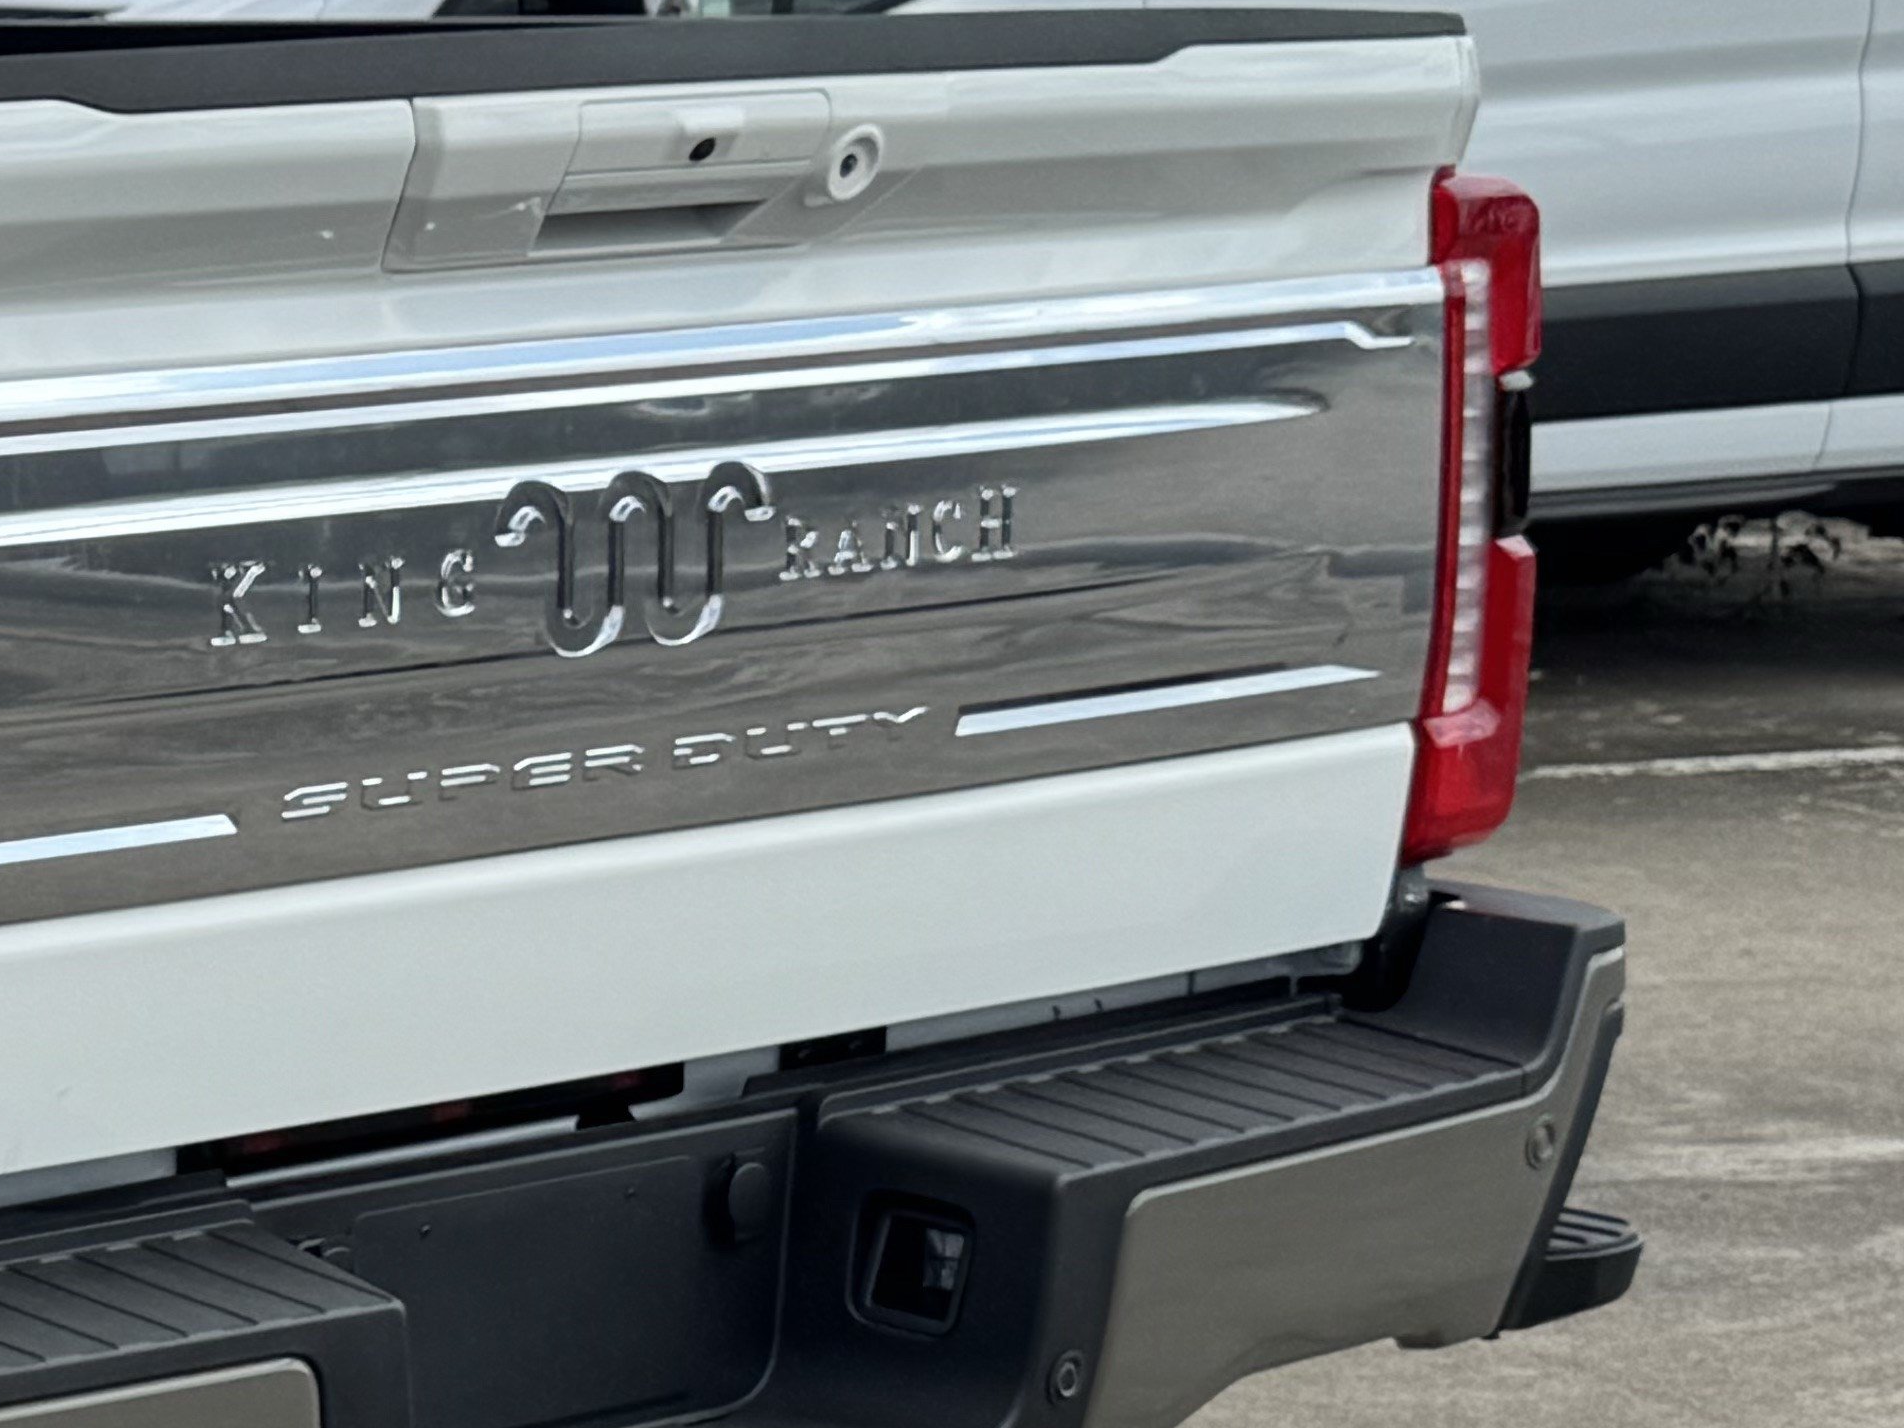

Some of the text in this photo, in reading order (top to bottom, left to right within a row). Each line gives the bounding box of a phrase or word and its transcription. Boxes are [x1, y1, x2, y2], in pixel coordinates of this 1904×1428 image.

[208, 485, 1019, 646] KING RANCH
[281, 706, 929, 822] SUPER DUTY
